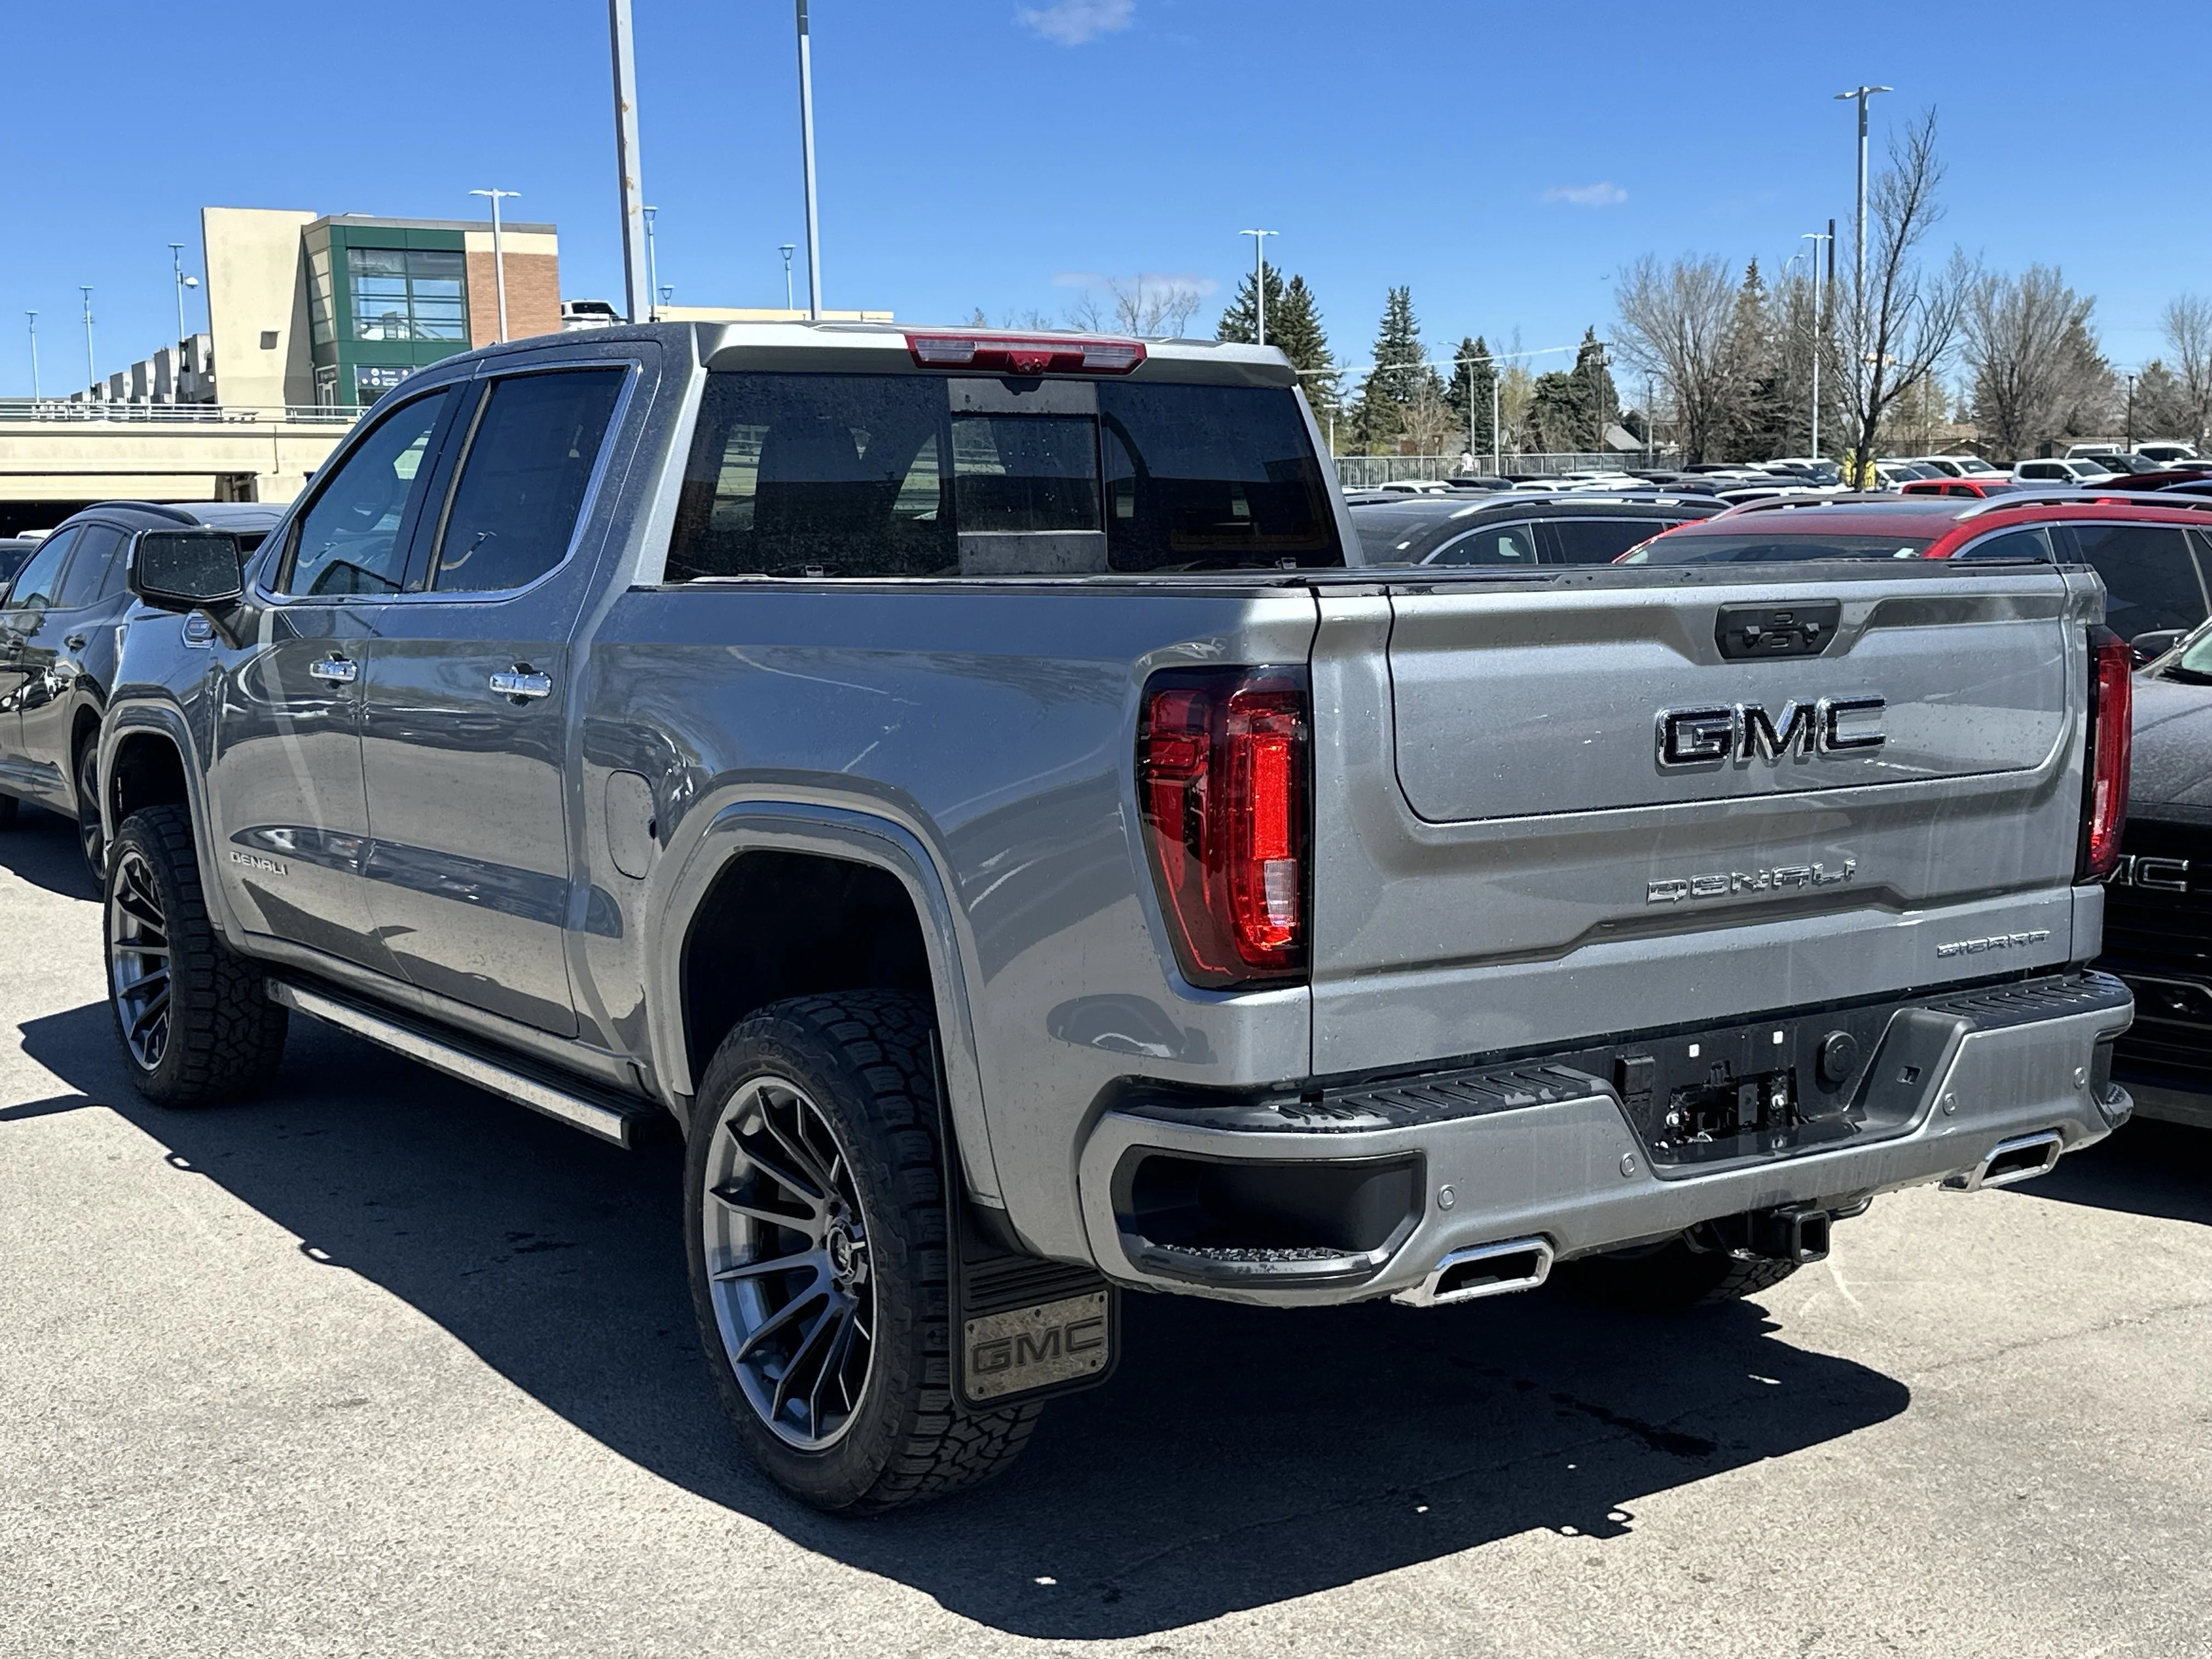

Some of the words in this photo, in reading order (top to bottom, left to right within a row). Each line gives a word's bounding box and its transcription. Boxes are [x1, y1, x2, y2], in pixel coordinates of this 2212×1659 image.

[1655, 693, 1887, 769] GMC
[230, 850, 288, 876] DENALI
[1647, 858, 1857, 905] DENALI
[2100, 854, 2190, 893] MC
[1937, 930, 2051, 958] SIERRA
[971, 1315, 1104, 1374] GMC
